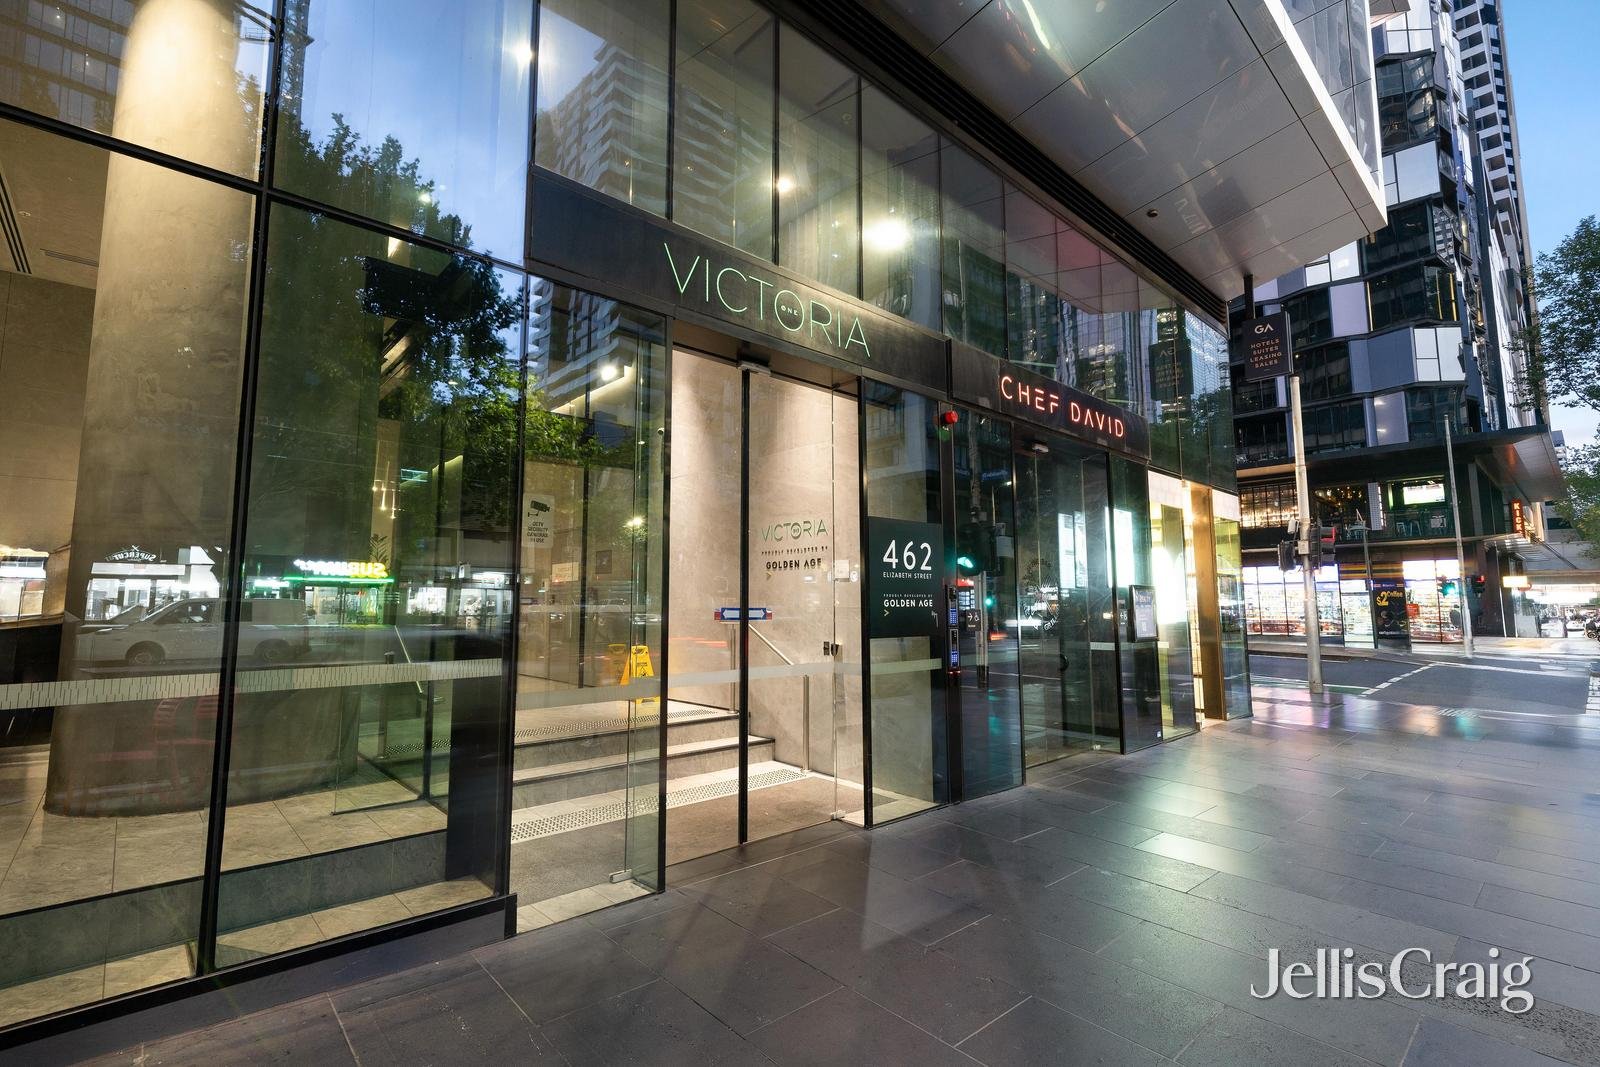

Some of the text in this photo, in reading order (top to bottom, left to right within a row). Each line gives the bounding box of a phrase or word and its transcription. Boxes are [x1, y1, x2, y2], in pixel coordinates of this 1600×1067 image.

[664, 242, 871, 358] VICTORIA
[780, 304, 799, 317] ONE
[1254, 323, 1274, 334] GA
[1250, 338, 1280, 349] HOTELS
[1252, 346, 1279, 356] SUITES
[1249, 352, 1282, 363] LEASING
[1254, 359, 1278, 369] SALES
[1000, 375, 1125, 438] CHEF DAVID
[761, 519, 828, 543] VICTORIA
[882, 539, 932, 571] 462
[766, 558, 822, 570] GOLDEN AGE
[883, 571, 932, 580] ELIZABETH STREET
[883, 599, 933, 608] GOLDEN AGE
